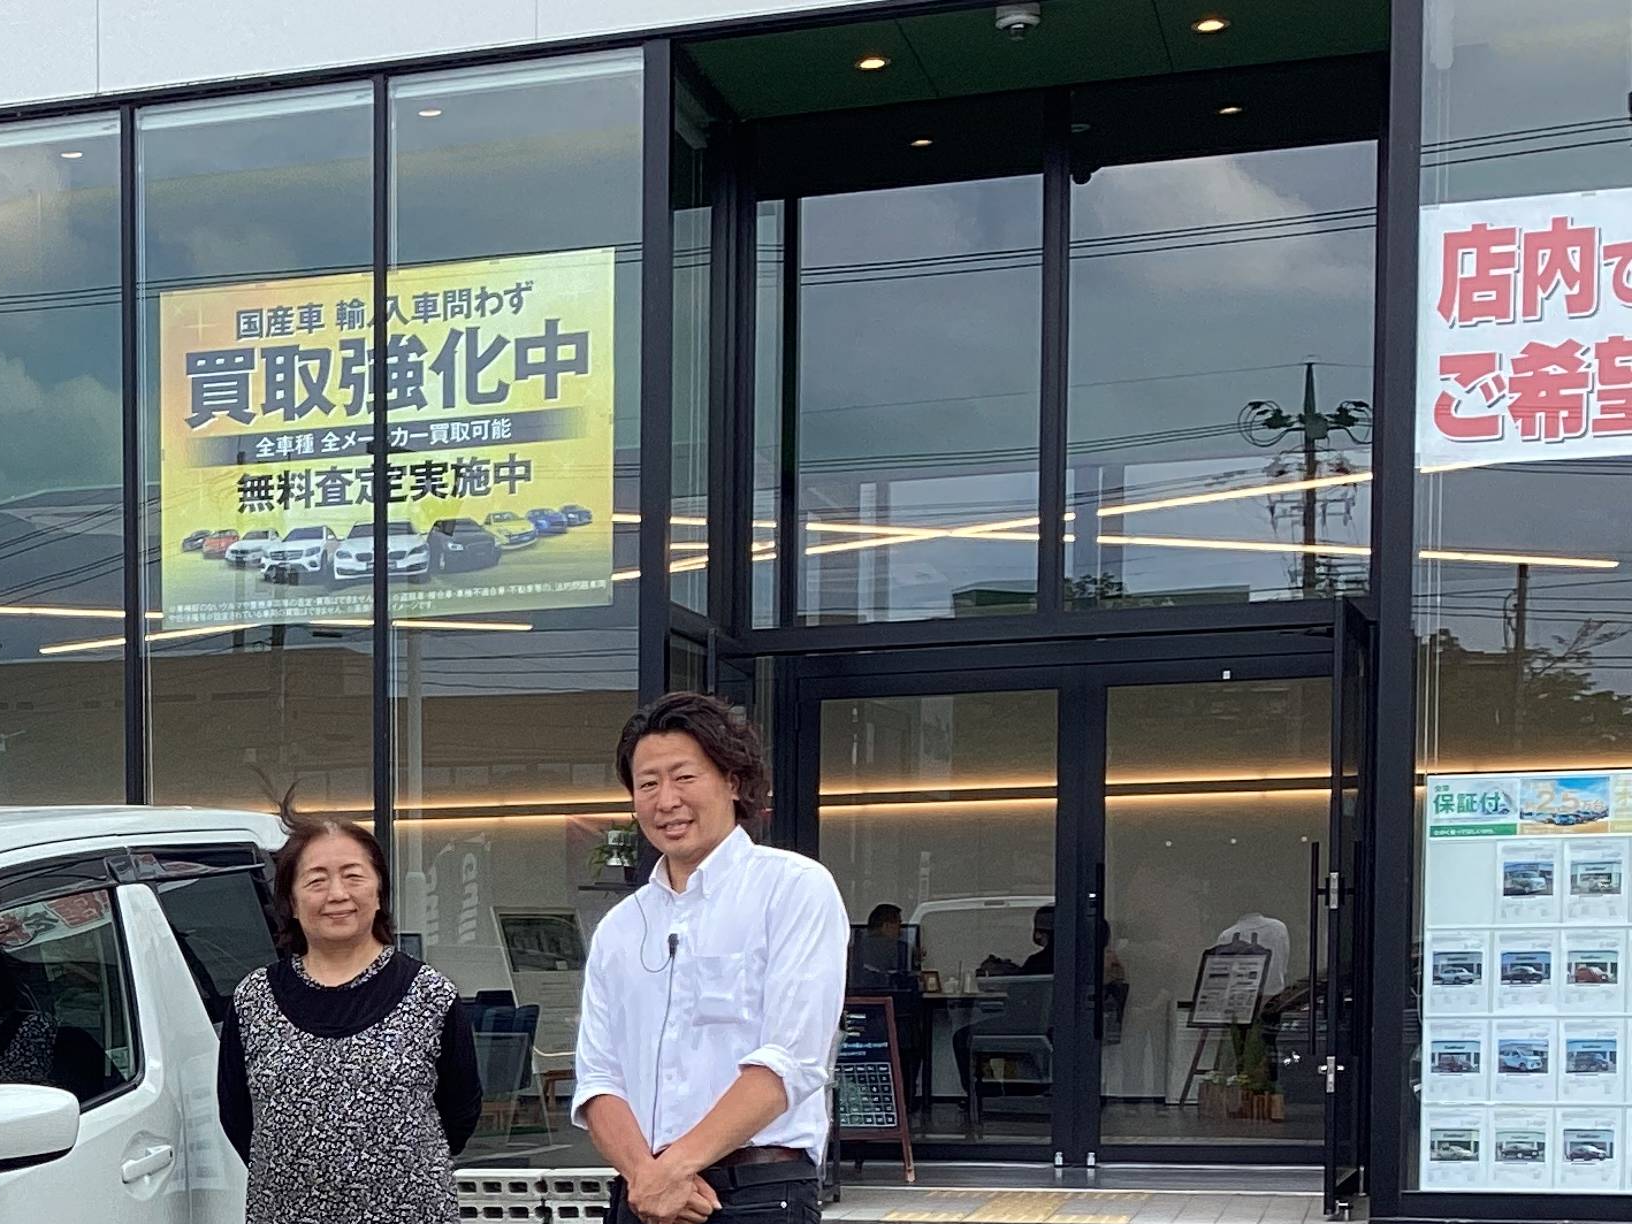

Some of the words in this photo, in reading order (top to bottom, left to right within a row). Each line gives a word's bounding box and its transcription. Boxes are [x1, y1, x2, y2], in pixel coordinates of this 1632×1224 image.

[236, 304, 325, 340] 国産車
[335, 280, 534, 332] 輸入車問わず
[184, 318, 590, 429] 買取強化中
[256, 433, 314, 458] 全車種
[321, 417, 512, 454] 全メーカー買取可能
[237, 452, 533, 514] 無料査定実施中
